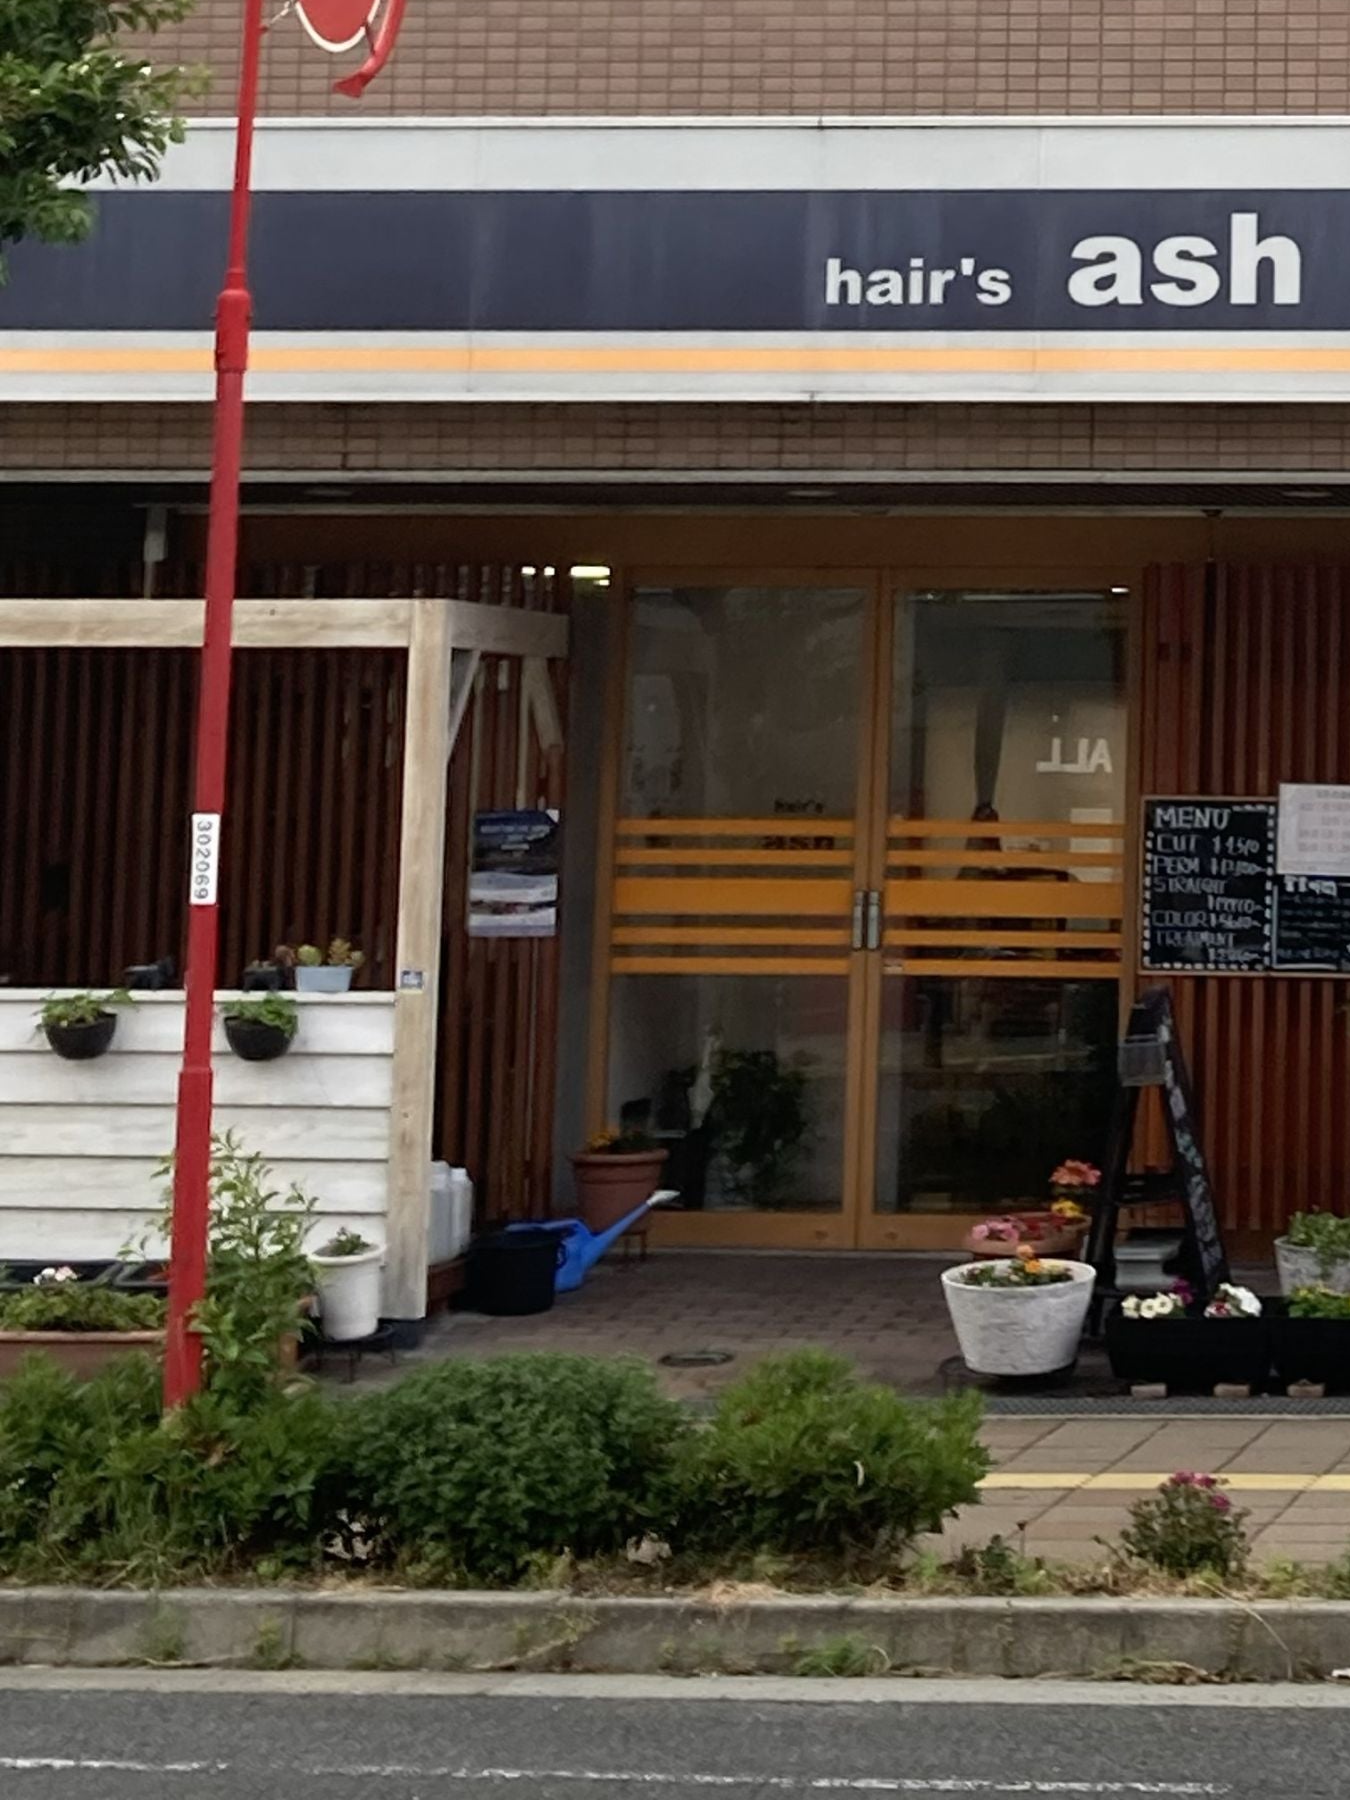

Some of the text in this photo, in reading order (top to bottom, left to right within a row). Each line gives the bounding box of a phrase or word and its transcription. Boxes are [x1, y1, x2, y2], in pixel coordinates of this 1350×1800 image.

[825, 212, 1302, 307] hair's ash
[1153, 806, 1232, 830] MENU
[1156, 834, 1199, 852] CUT
[193, 820, 213, 900] 302069
